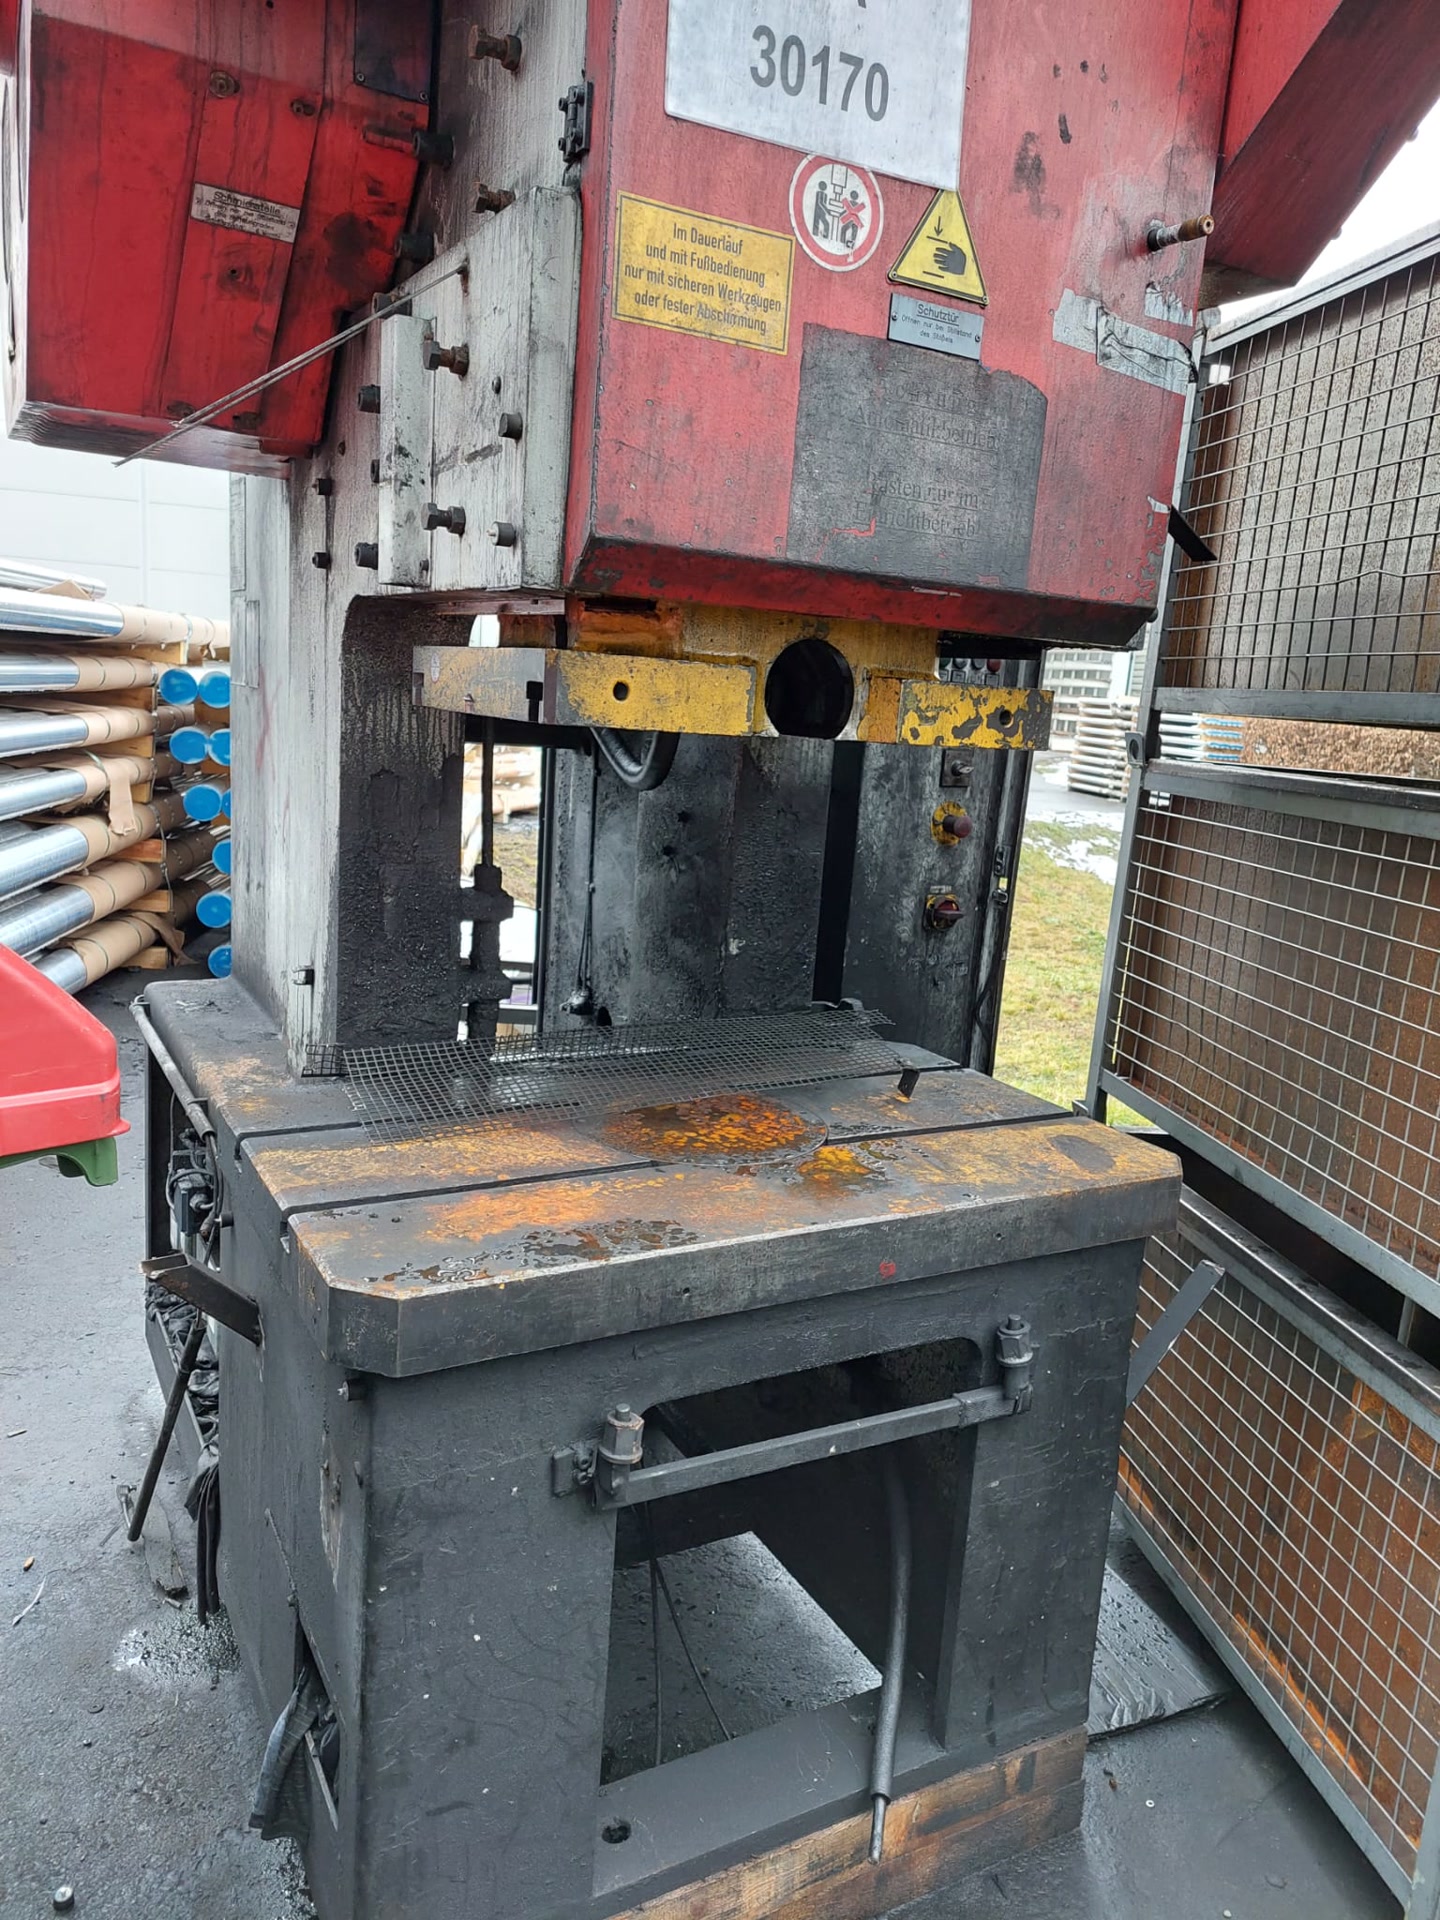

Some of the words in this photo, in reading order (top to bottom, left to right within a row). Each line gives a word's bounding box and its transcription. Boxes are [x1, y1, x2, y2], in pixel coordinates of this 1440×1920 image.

[750, 25, 889, 121] 30170
[673, 222, 687, 242] Im
[690, 229, 743, 255] Dauerlauf
[646, 244, 667, 260] und
[670, 250, 687, 267] mit
[690, 253, 765, 288] Fußbedienung
[624, 264, 645, 279] nur
[647, 268, 665, 285] mit
[667, 274, 714, 296] sicheren
[718, 282, 781, 313] Werkzeugen
[634, 290, 660, 309] oder
[663, 295, 695, 316] fester
[697, 303, 766, 334] Abschirmung
[917, 303, 959, 322] Schutztür
